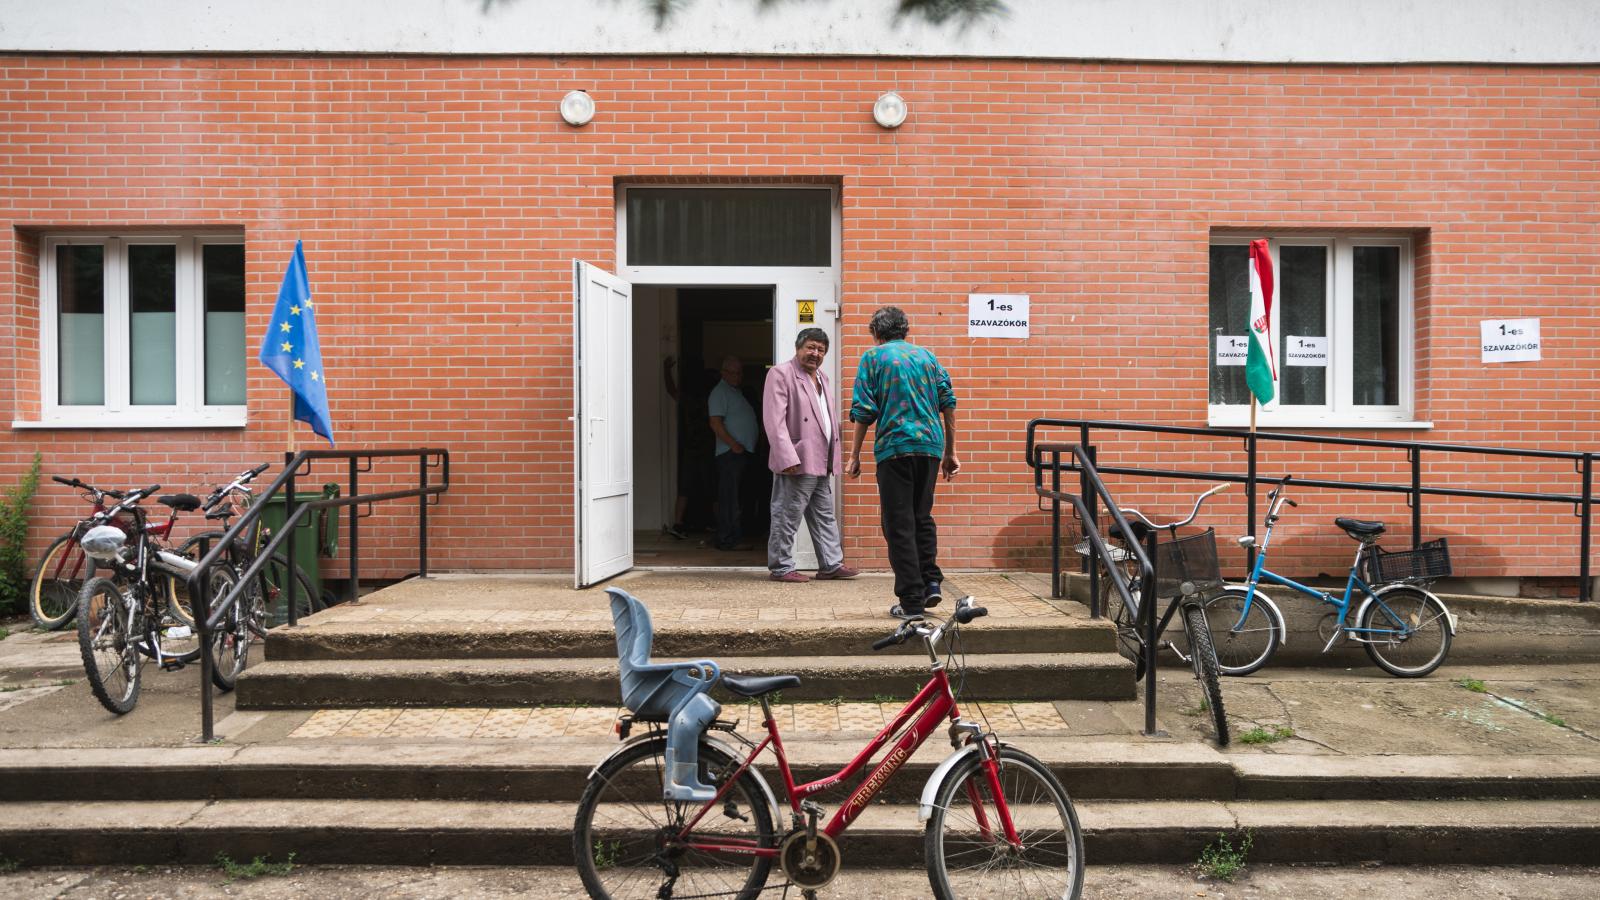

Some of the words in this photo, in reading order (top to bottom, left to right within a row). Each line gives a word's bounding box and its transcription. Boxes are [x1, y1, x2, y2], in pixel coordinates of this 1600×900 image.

[987, 299, 1013, 311] 1-es
[970, 317, 1028, 327] SZAVAZÓKÖR
[1498, 324, 1524, 336] 1-es
[1229, 339, 1248, 348] 1-es
[1298, 339, 1316, 348] 1-es
[852, 747, 907, 807] TREKKING
